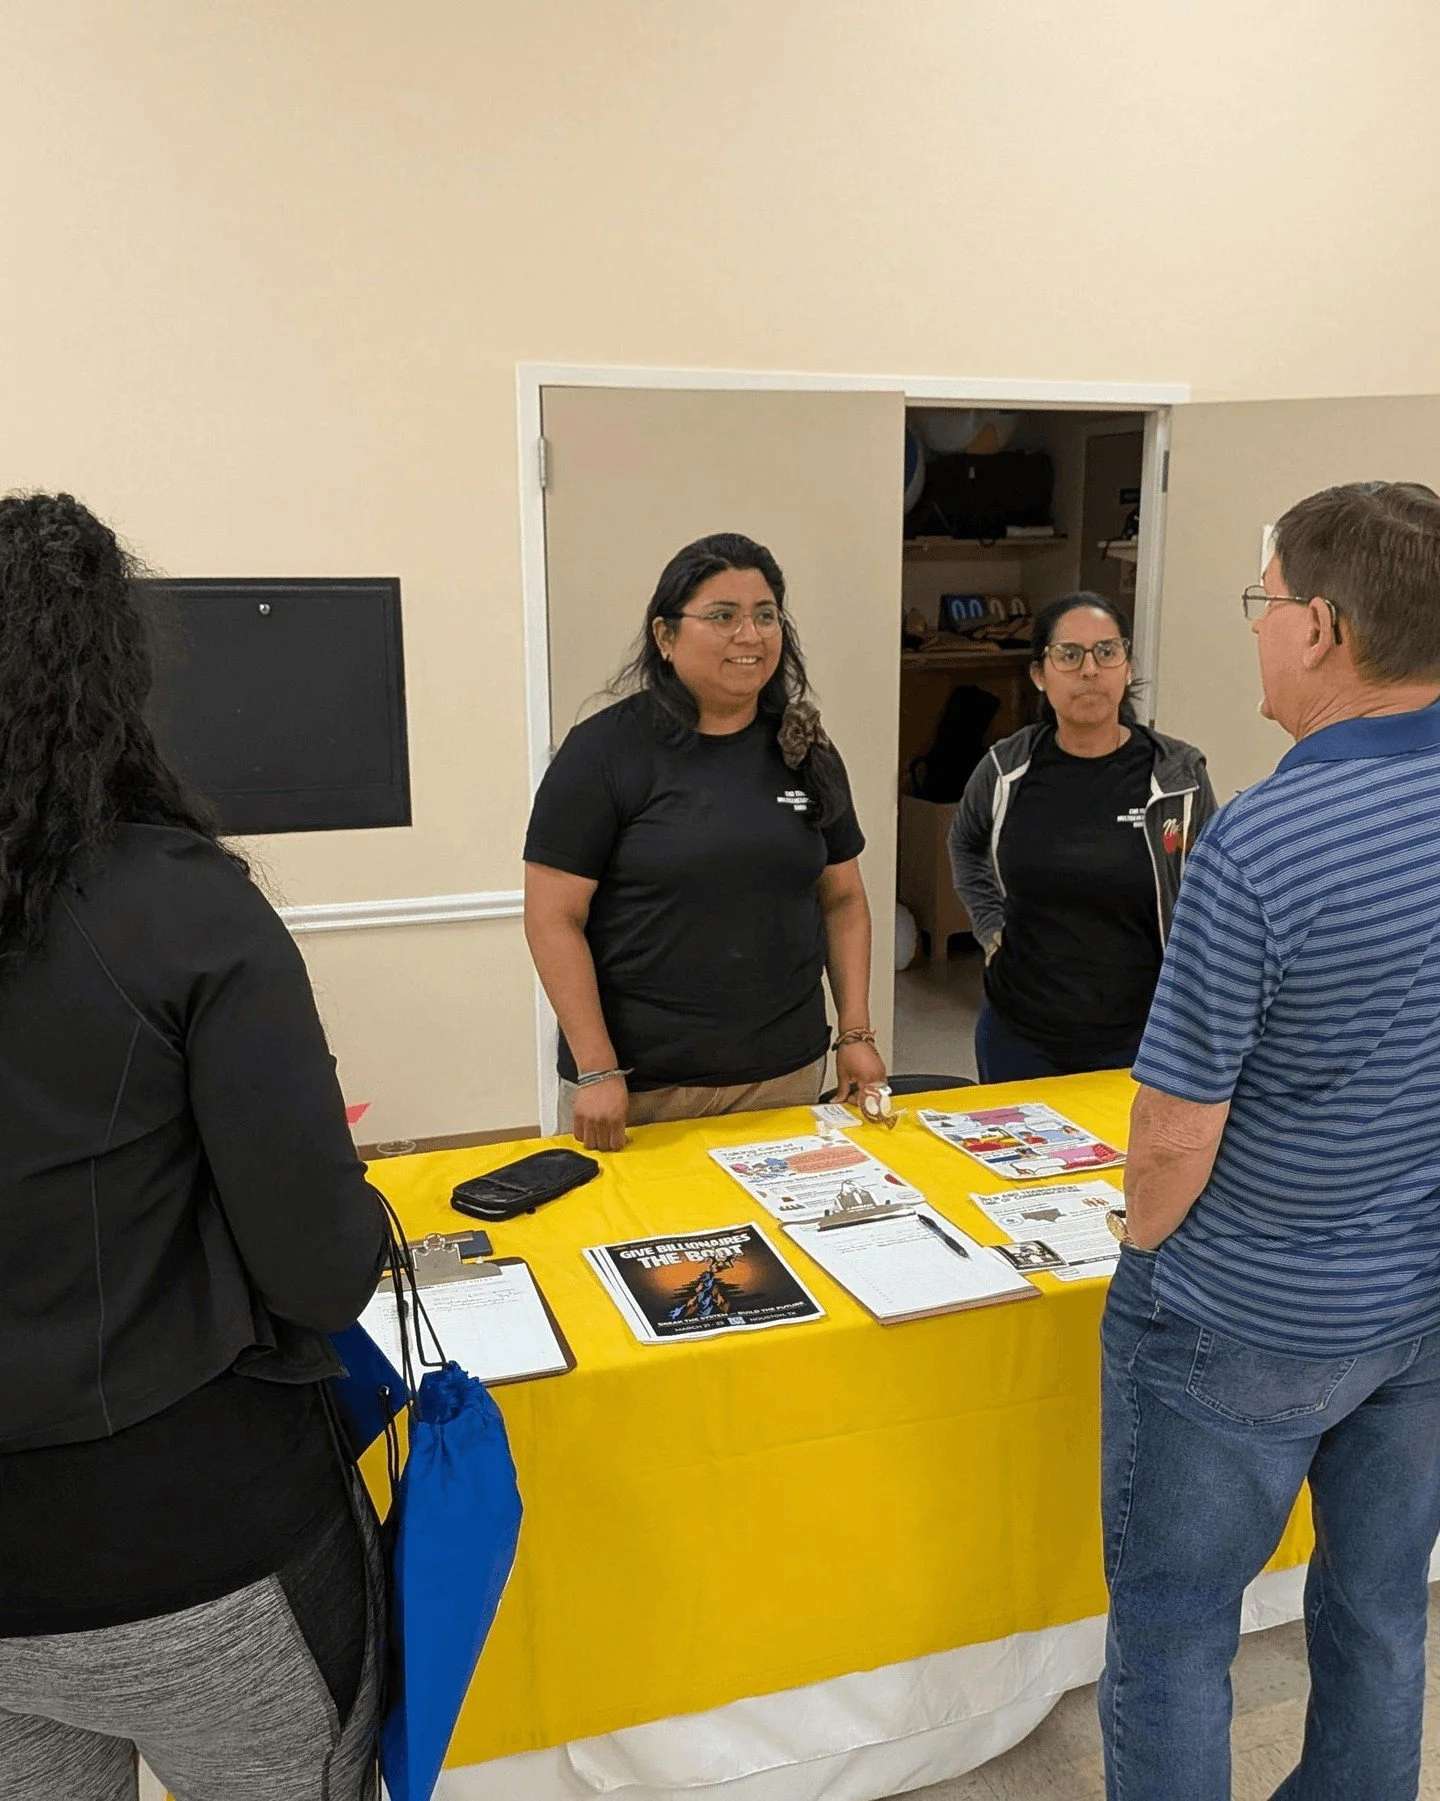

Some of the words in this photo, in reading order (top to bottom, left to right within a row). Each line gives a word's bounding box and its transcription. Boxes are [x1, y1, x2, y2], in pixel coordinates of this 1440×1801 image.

[747, 1146, 804, 1158] Community
[619, 1246, 656, 1259] GIVE
[655, 1233, 752, 1254] BILLIONAIRES
[637, 1251, 683, 1269] THE
[684, 1244, 744, 1262] BOOT
[699, 1313, 729, 1321] SYSTEM
[775, 1300, 805, 1310] FUTURE
[675, 1324, 703, 1332] MARCH
